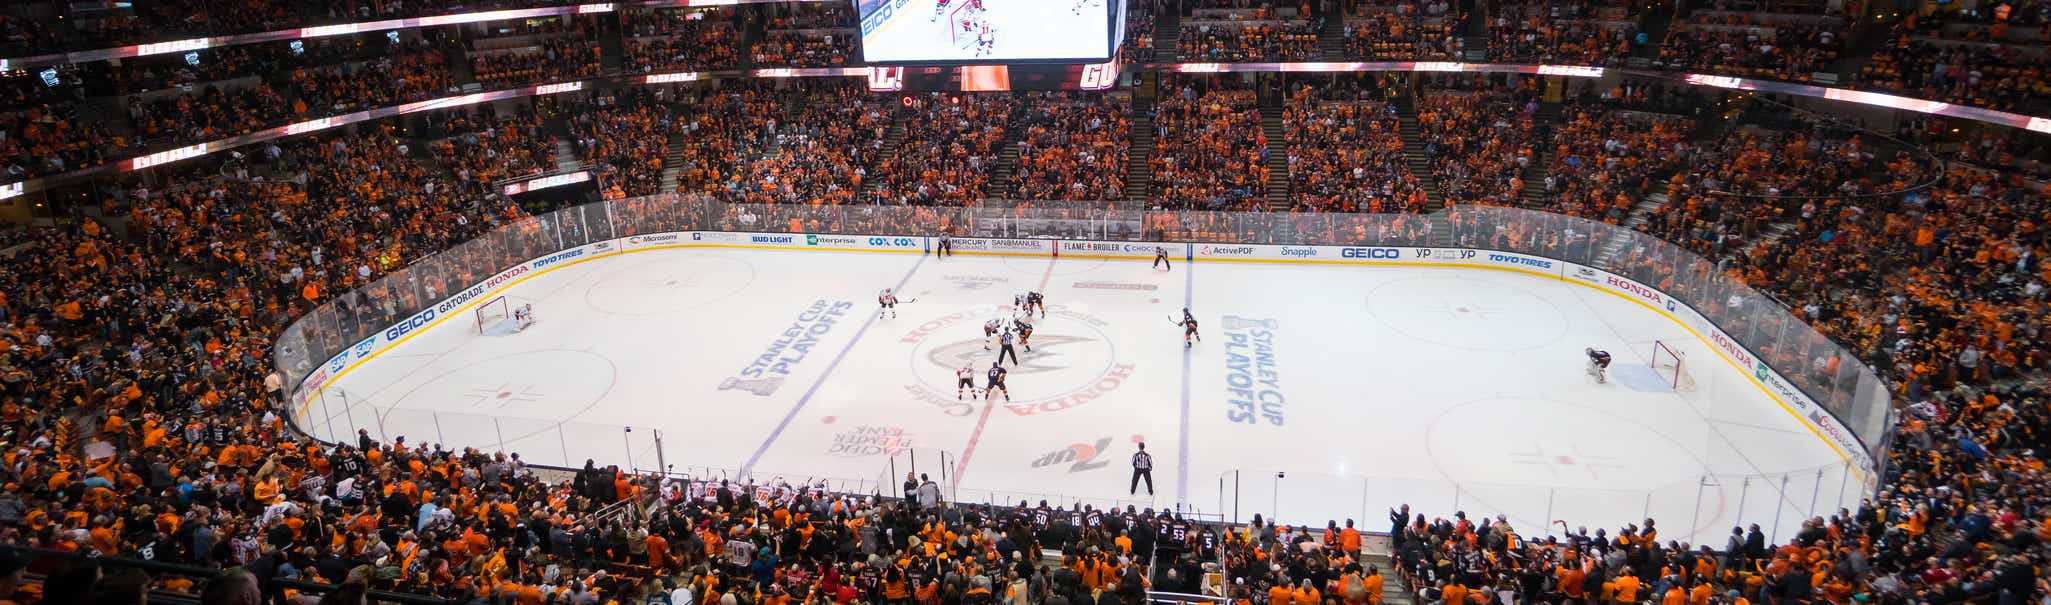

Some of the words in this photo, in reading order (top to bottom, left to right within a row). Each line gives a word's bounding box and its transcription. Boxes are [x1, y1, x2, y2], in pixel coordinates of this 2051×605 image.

[643, 233, 677, 242] Microsemi
[752, 235, 769, 243] BUD
[770, 236, 793, 244] LIGHT
[807, 236, 856, 246] enterprise
[868, 237, 890, 247] COX
[894, 238, 916, 247] COX
[1064, 242, 1085, 251] FLAME
[1093, 243, 1119, 252] BROILER
[1213, 246, 1254, 255] ActivePDF
[1281, 246, 1317, 258] Snapple
[533, 256, 556, 269] TOYO
[557, 248, 583, 261] TIRES
[1341, 247, 1400, 259] GEICO
[1416, 248, 1431, 259] yp
[1460, 249, 1476, 259] yp
[1489, 253, 1519, 264] TOYO
[1520, 257, 1552, 269] TIRES
[486, 264, 529, 289] HONDA
[1607, 276, 1662, 304] HONDA
[439, 285, 485, 314] GATORADE
[385, 308, 435, 342] GEICO
[741, 322, 805, 378] STANLEY
[798, 299, 826, 323] CUP
[770, 300, 853, 375] PLAYOFFS
[1710, 329, 1752, 370] HONDA
[1251, 329, 1279, 389] STANLEY
[1224, 332, 1256, 425] PLAYOFFS
[1003, 363, 1136, 416] HONDA
[1759, 364, 1806, 410] enterprise
[1259, 390, 1285, 426] CUP
[344, 460, 357, 471] 10
[1036, 514, 1047, 525] 50
[1072, 516, 1080, 526] 18
[1088, 515, 1100, 526] 44
[1161, 524, 1167, 534] 2
[1173, 529, 1184, 540] 53
[1205, 538, 1212, 548] 5
